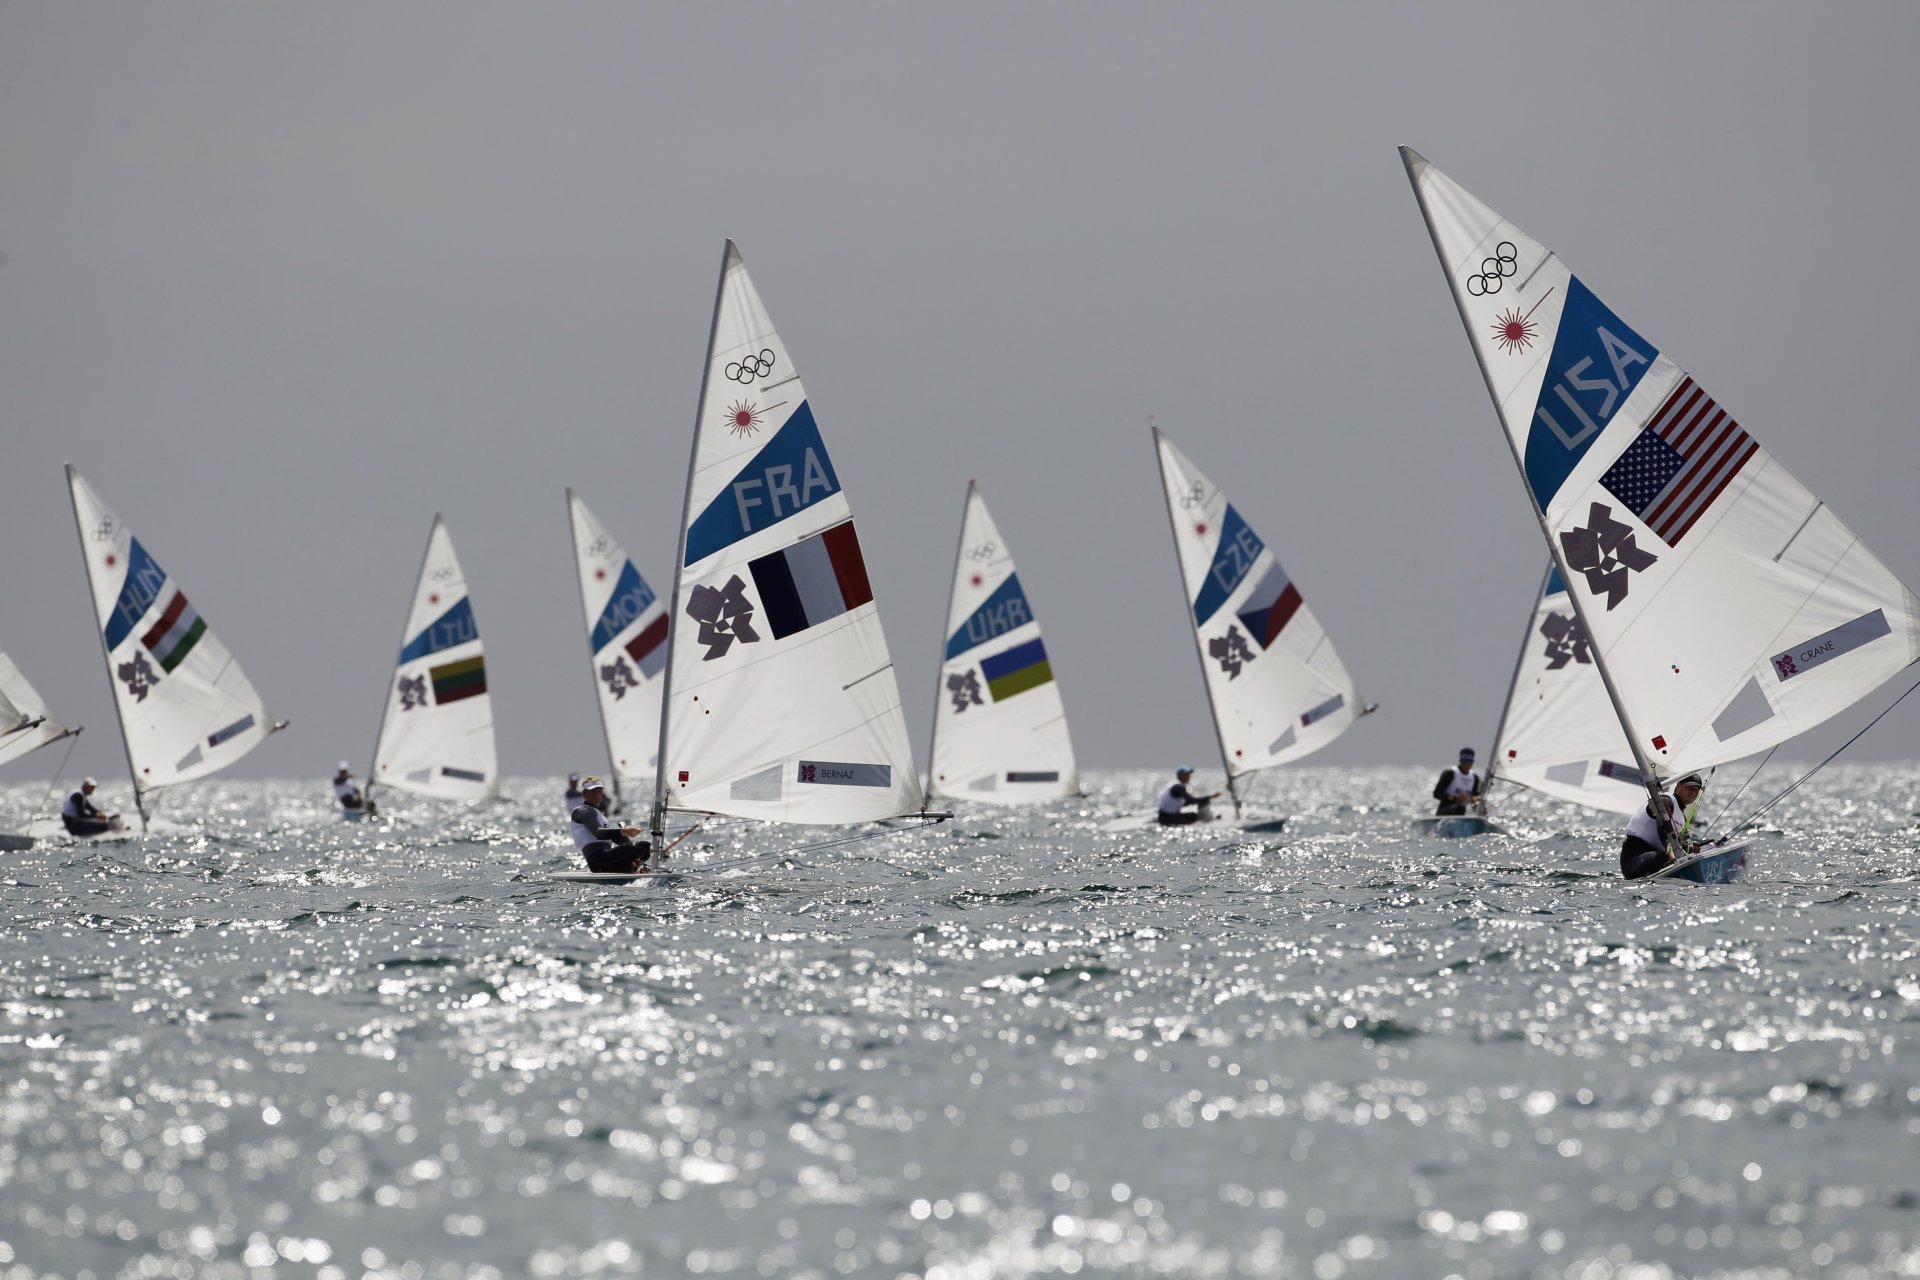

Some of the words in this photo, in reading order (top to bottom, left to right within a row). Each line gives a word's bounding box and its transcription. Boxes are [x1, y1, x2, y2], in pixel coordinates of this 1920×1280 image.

[1536, 326, 1649, 452] USA
[733, 446, 833, 533] FRA
[1212, 526, 1260, 594] CZE
[119, 557, 163, 626] HUN
[602, 580, 653, 638] MON
[967, 597, 1027, 643] UKR
[430, 614, 474, 651] LTU
[1800, 640, 1835, 662] CRANE
[821, 769, 854, 779] BERNAZ
